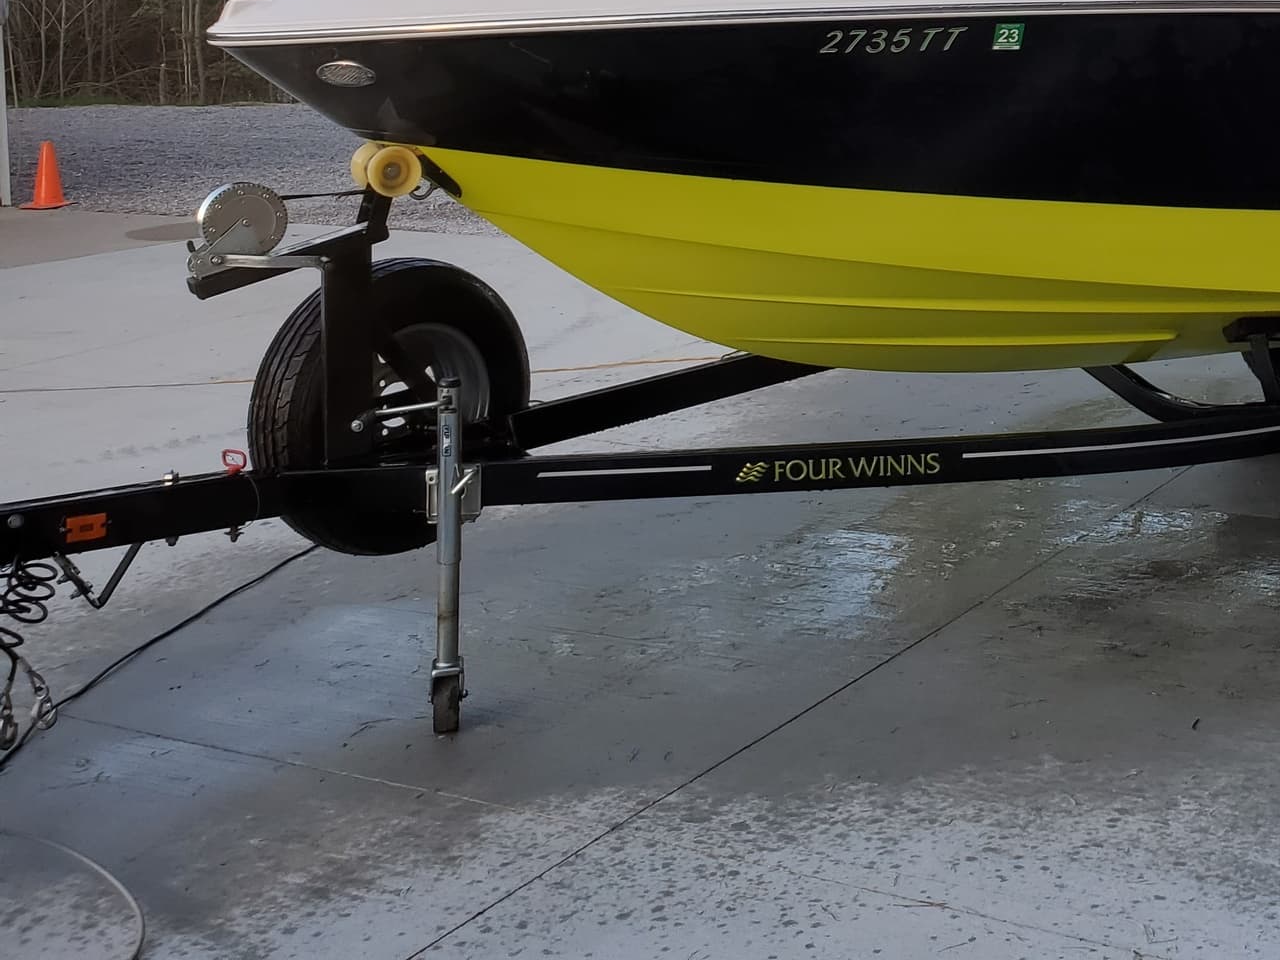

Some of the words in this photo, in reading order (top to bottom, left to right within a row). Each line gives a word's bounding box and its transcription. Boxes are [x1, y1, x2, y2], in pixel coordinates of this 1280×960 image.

[819, 28, 913, 54] 2735
[919, 26, 969, 52] TT
[997, 29, 1019, 42] 23
[773, 457, 846, 482] FOUR
[847, 452, 941, 478] WINNS
